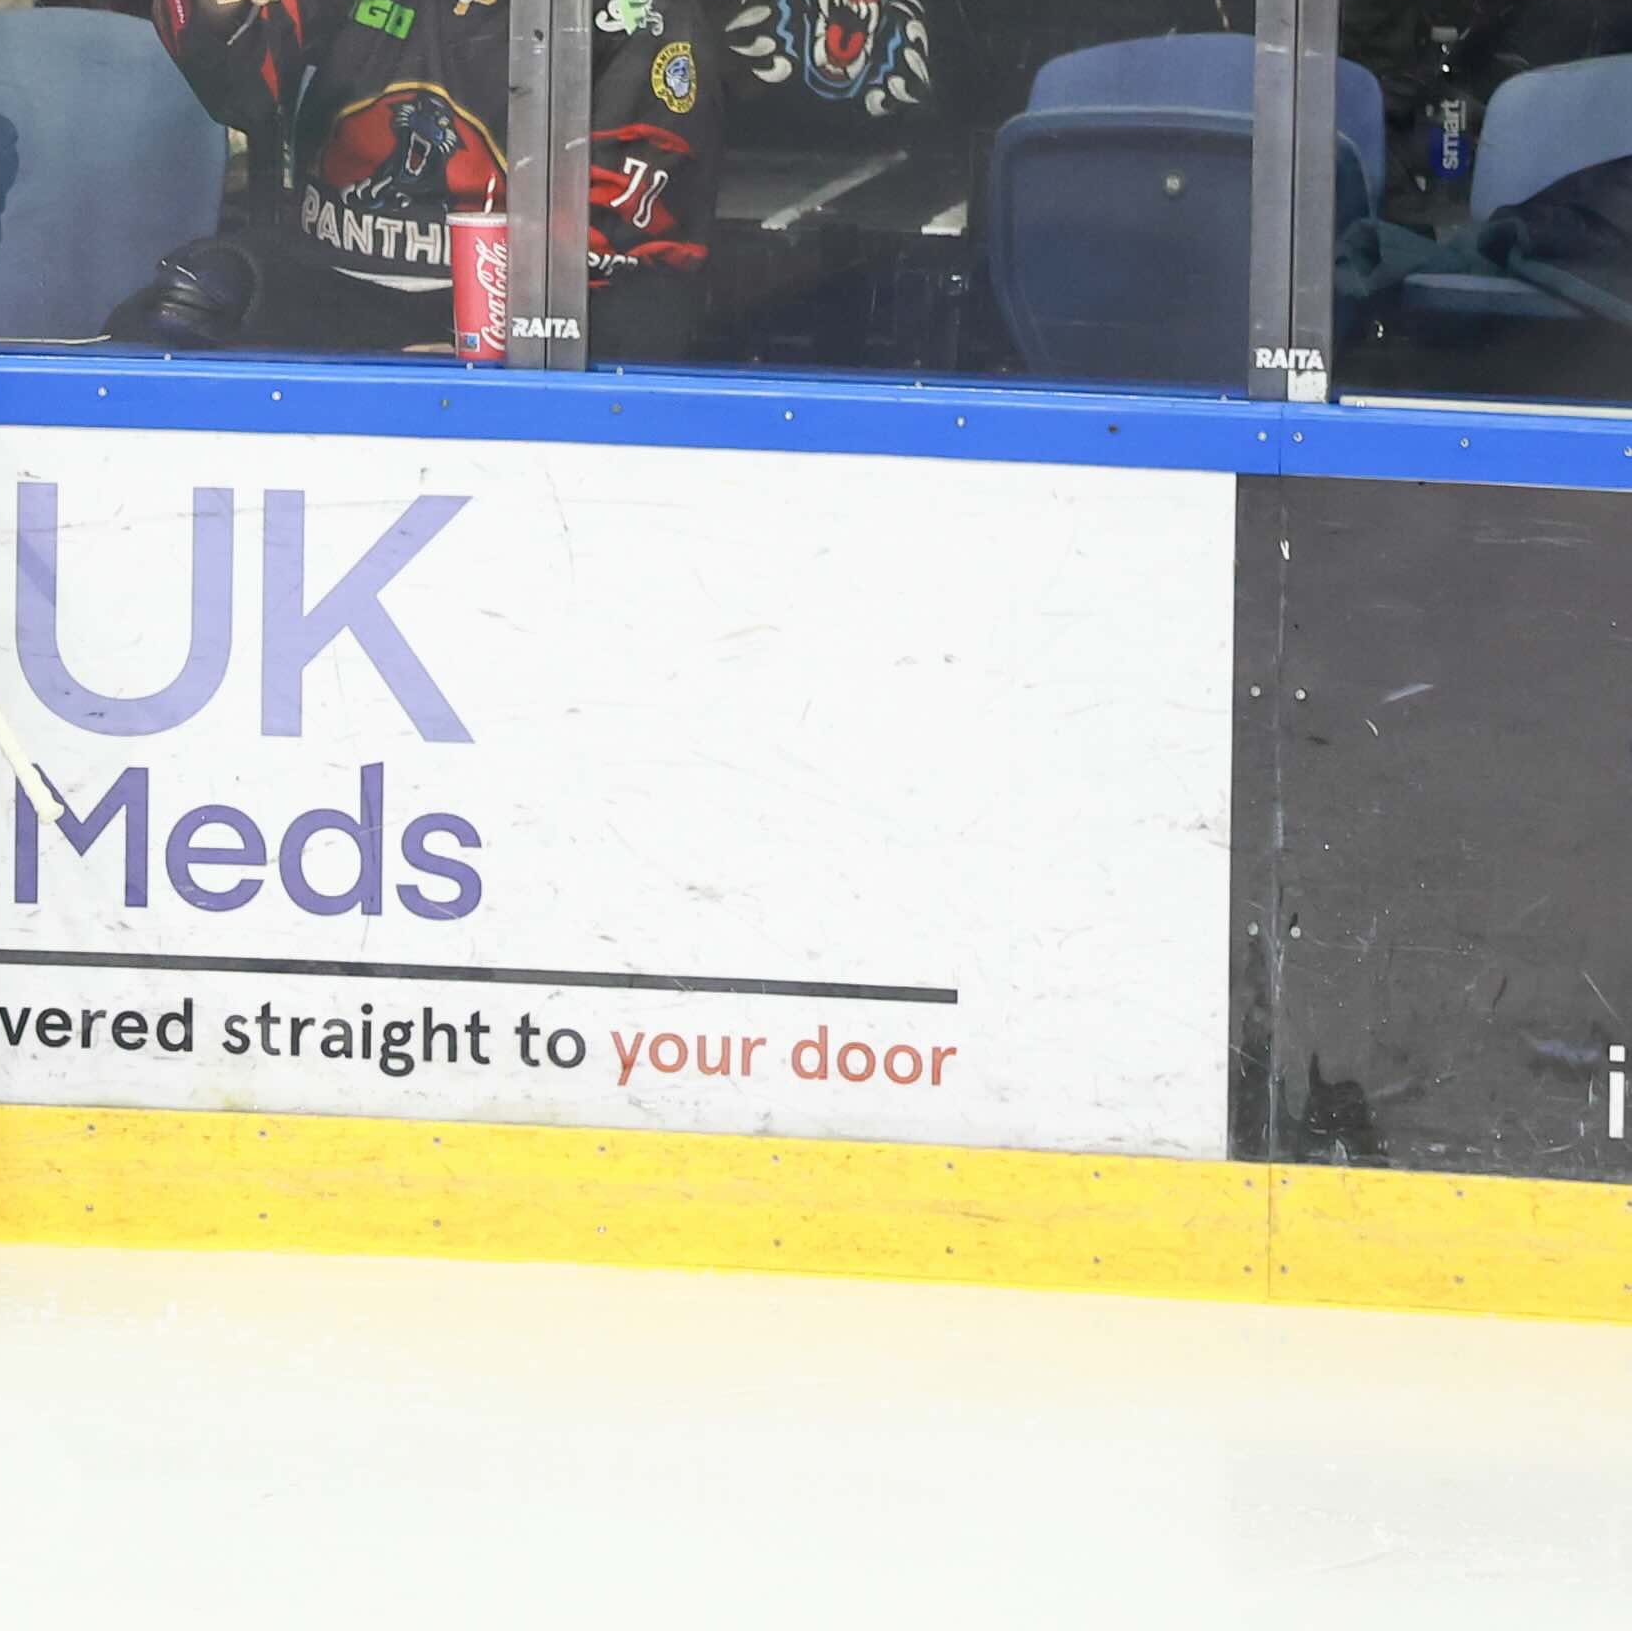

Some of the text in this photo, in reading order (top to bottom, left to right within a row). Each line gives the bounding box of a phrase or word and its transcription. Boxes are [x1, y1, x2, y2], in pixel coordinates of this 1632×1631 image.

[1442, 98, 1460, 171] smart
[301, 183, 452, 266] PANTH
[511, 316, 581, 339] RAITA
[1255, 347, 1325, 370] RAITA
[14, 481, 477, 746] UK
[12, 761, 485, 921] Meds
[221, 1004, 494, 1074] straight
[515, 1014, 587, 1070] to
[610, 1027, 768, 1085] your
[790, 1023, 960, 1087] door
[1608, 1043, 1626, 1139] i
